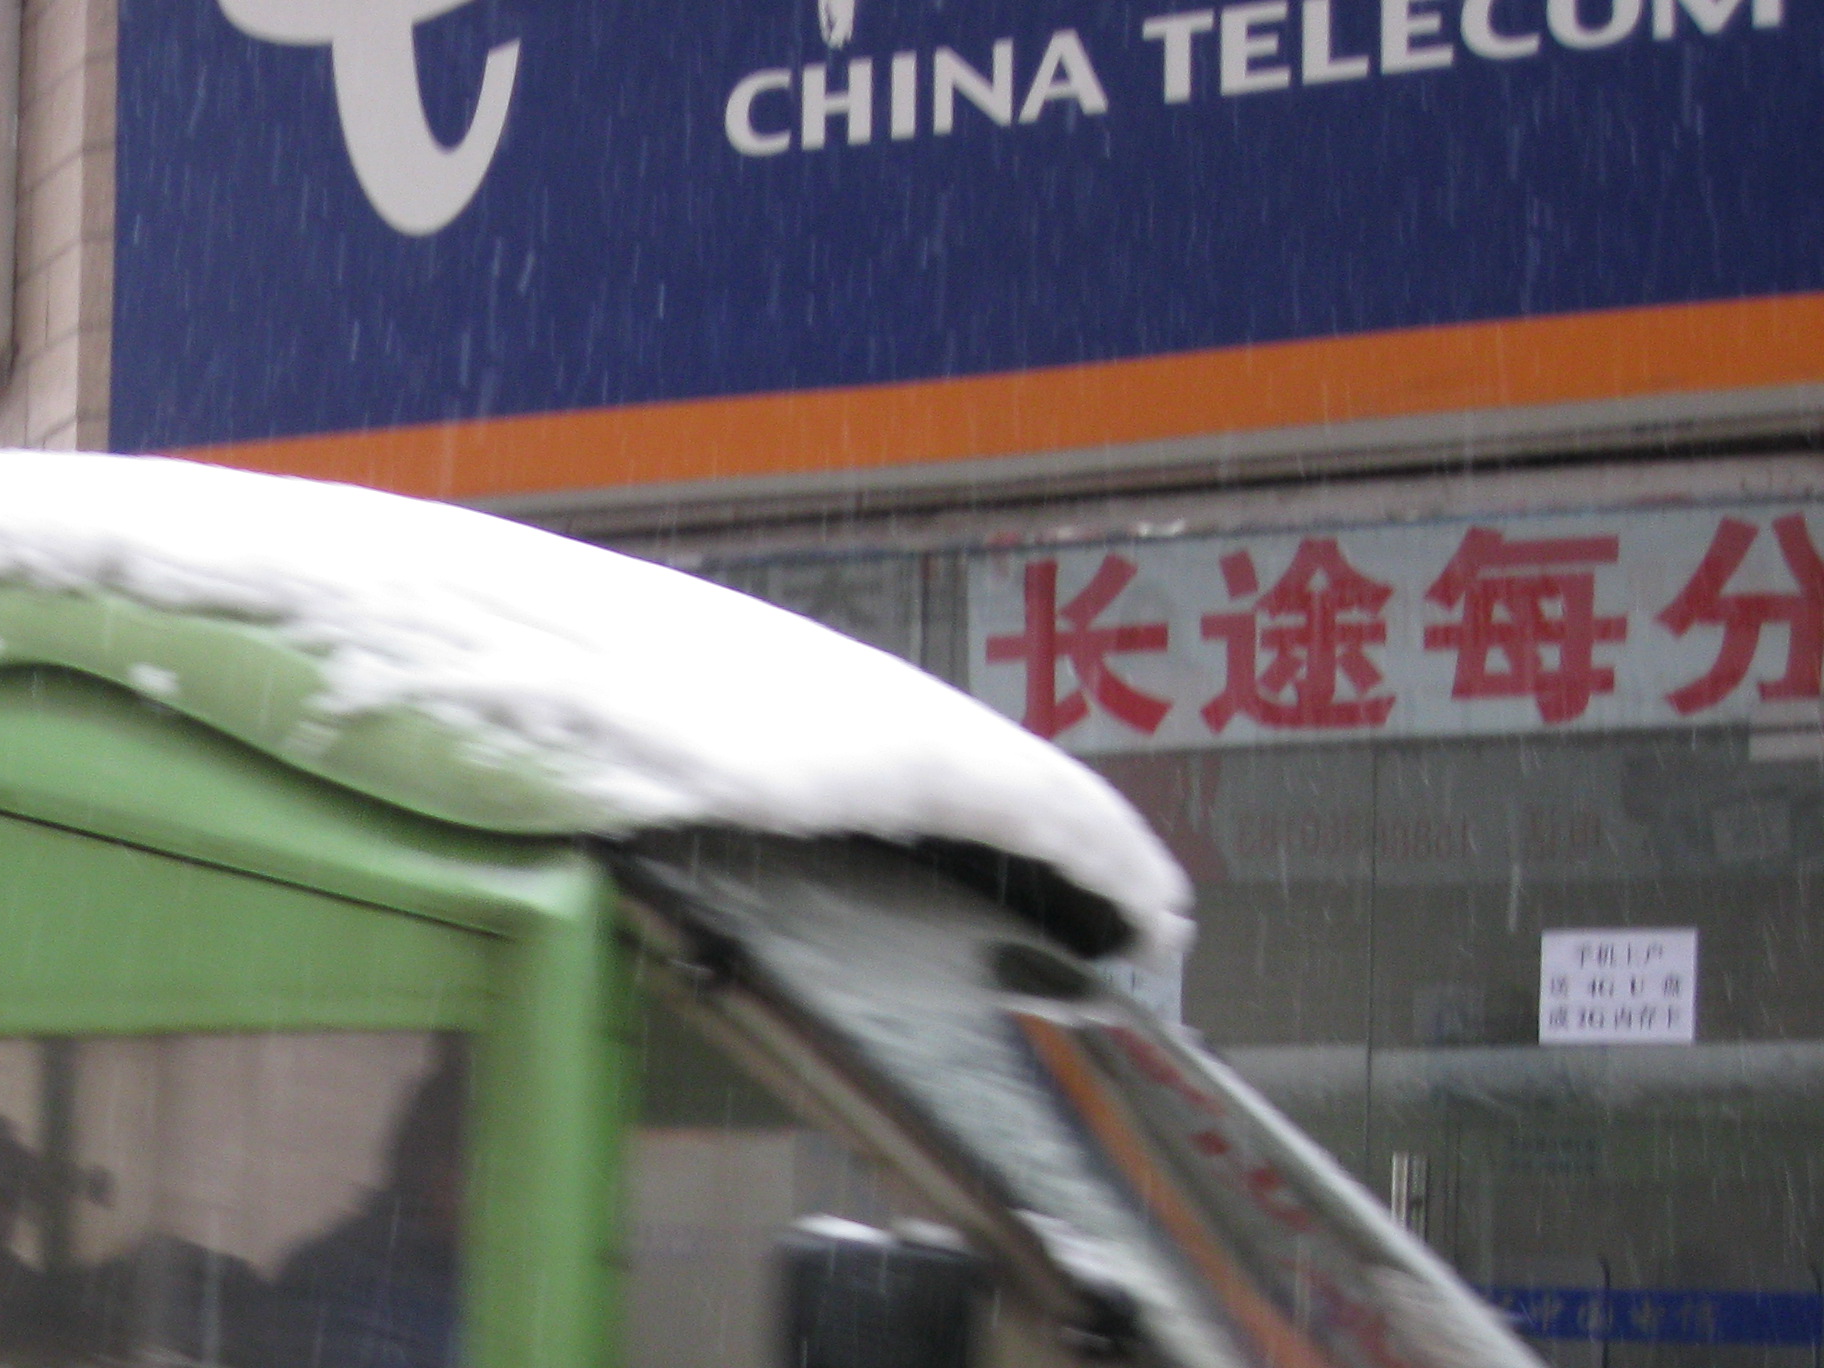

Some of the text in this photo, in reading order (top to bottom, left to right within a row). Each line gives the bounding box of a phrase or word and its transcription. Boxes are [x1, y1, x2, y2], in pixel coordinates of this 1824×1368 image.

[724, 29, 1108, 157] CHINA
[986, 513, 1824, 738] 长途每分
